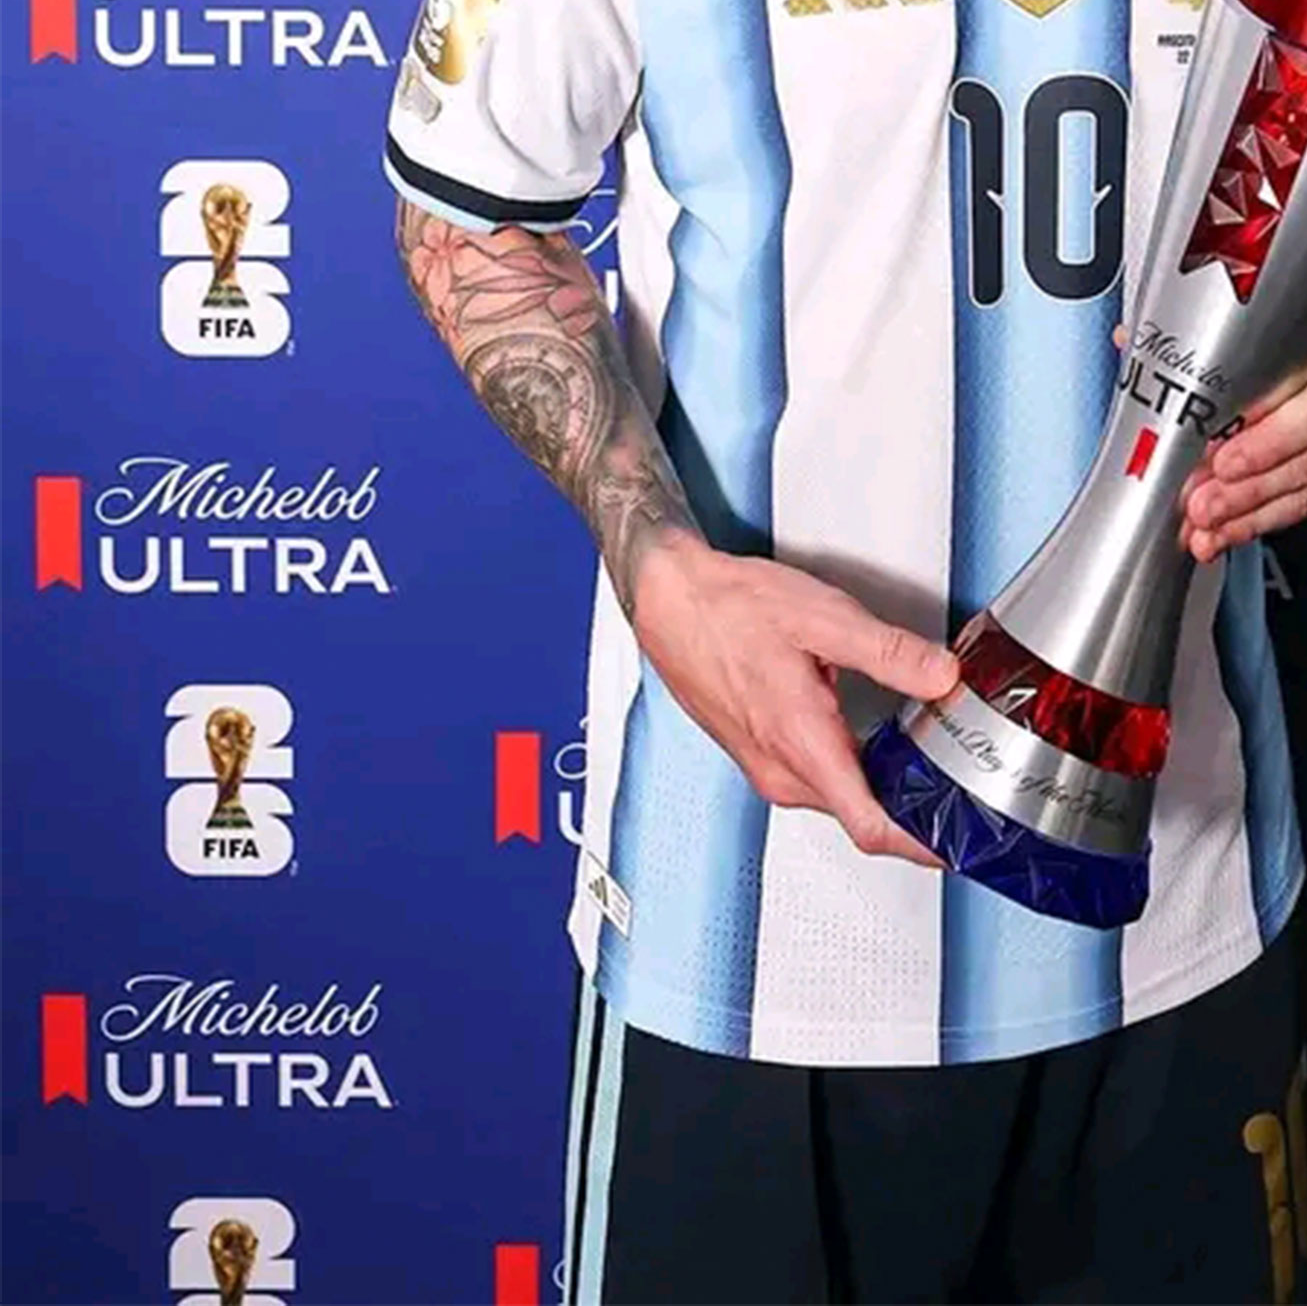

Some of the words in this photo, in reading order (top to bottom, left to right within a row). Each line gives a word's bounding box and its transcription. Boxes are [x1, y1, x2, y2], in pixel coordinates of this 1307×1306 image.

[95, 8, 389, 67] ULTRA
[949, 71, 1134, 309] 10
[199, 317, 256, 339] FIFA
[94, 457, 380, 526] Michelob
[100, 536, 389, 594] ULTRA
[203, 838, 260, 859] FIFA
[100, 974, 382, 1042] Michelob
[105, 1052, 389, 1108] ULTRA
